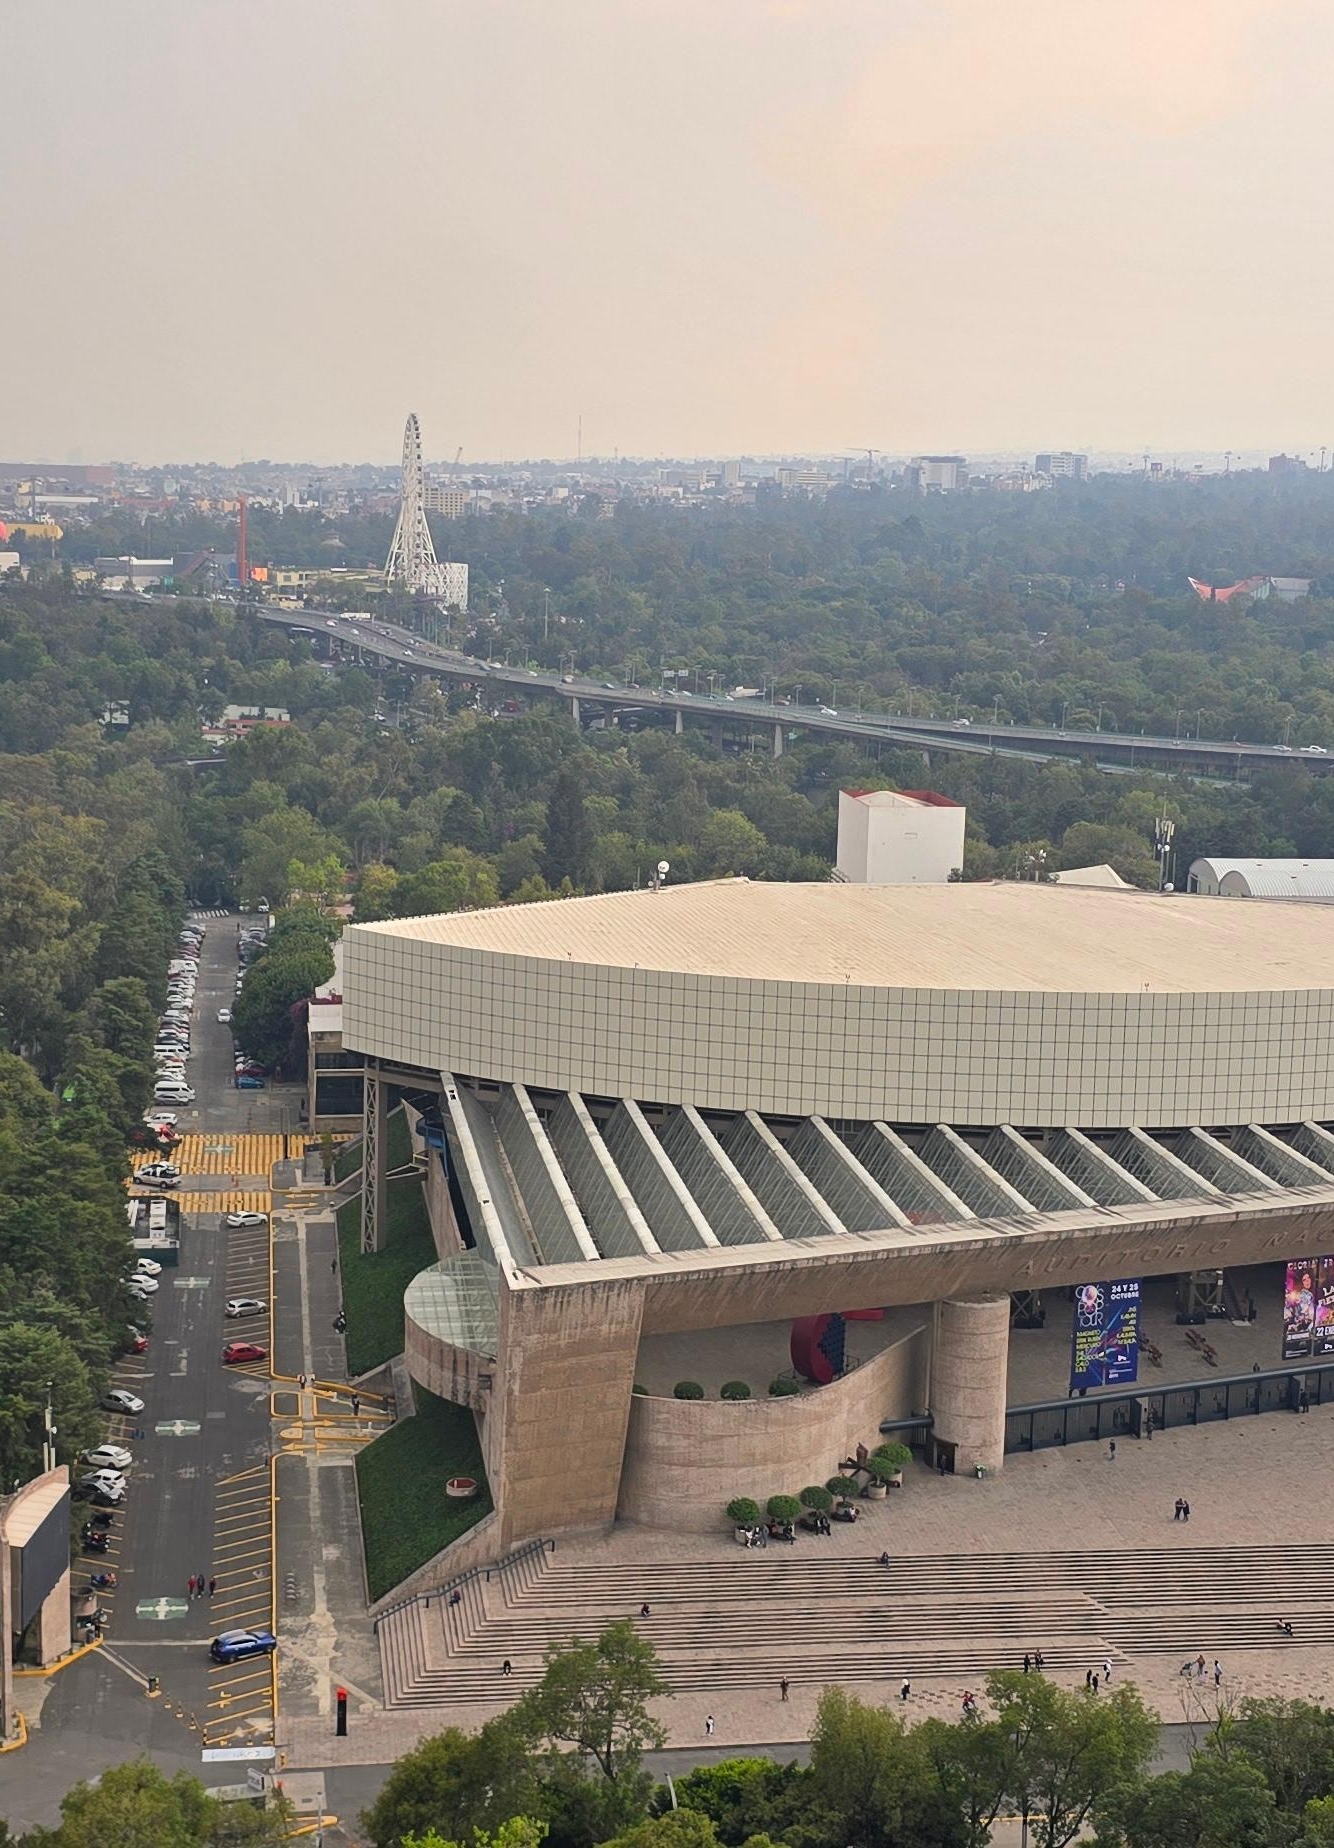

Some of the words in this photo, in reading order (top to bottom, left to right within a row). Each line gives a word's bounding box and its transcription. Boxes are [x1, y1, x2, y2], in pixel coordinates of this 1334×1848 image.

[1011, 1239, 1231, 1277] AUDITORIO
[1110, 1291, 1139, 1300] OCTUBRE
[1078, 1300, 1105, 1318] POP
[1080, 1312, 1104, 1327] TOUR
[1316, 1327, 1324, 1337] 22
